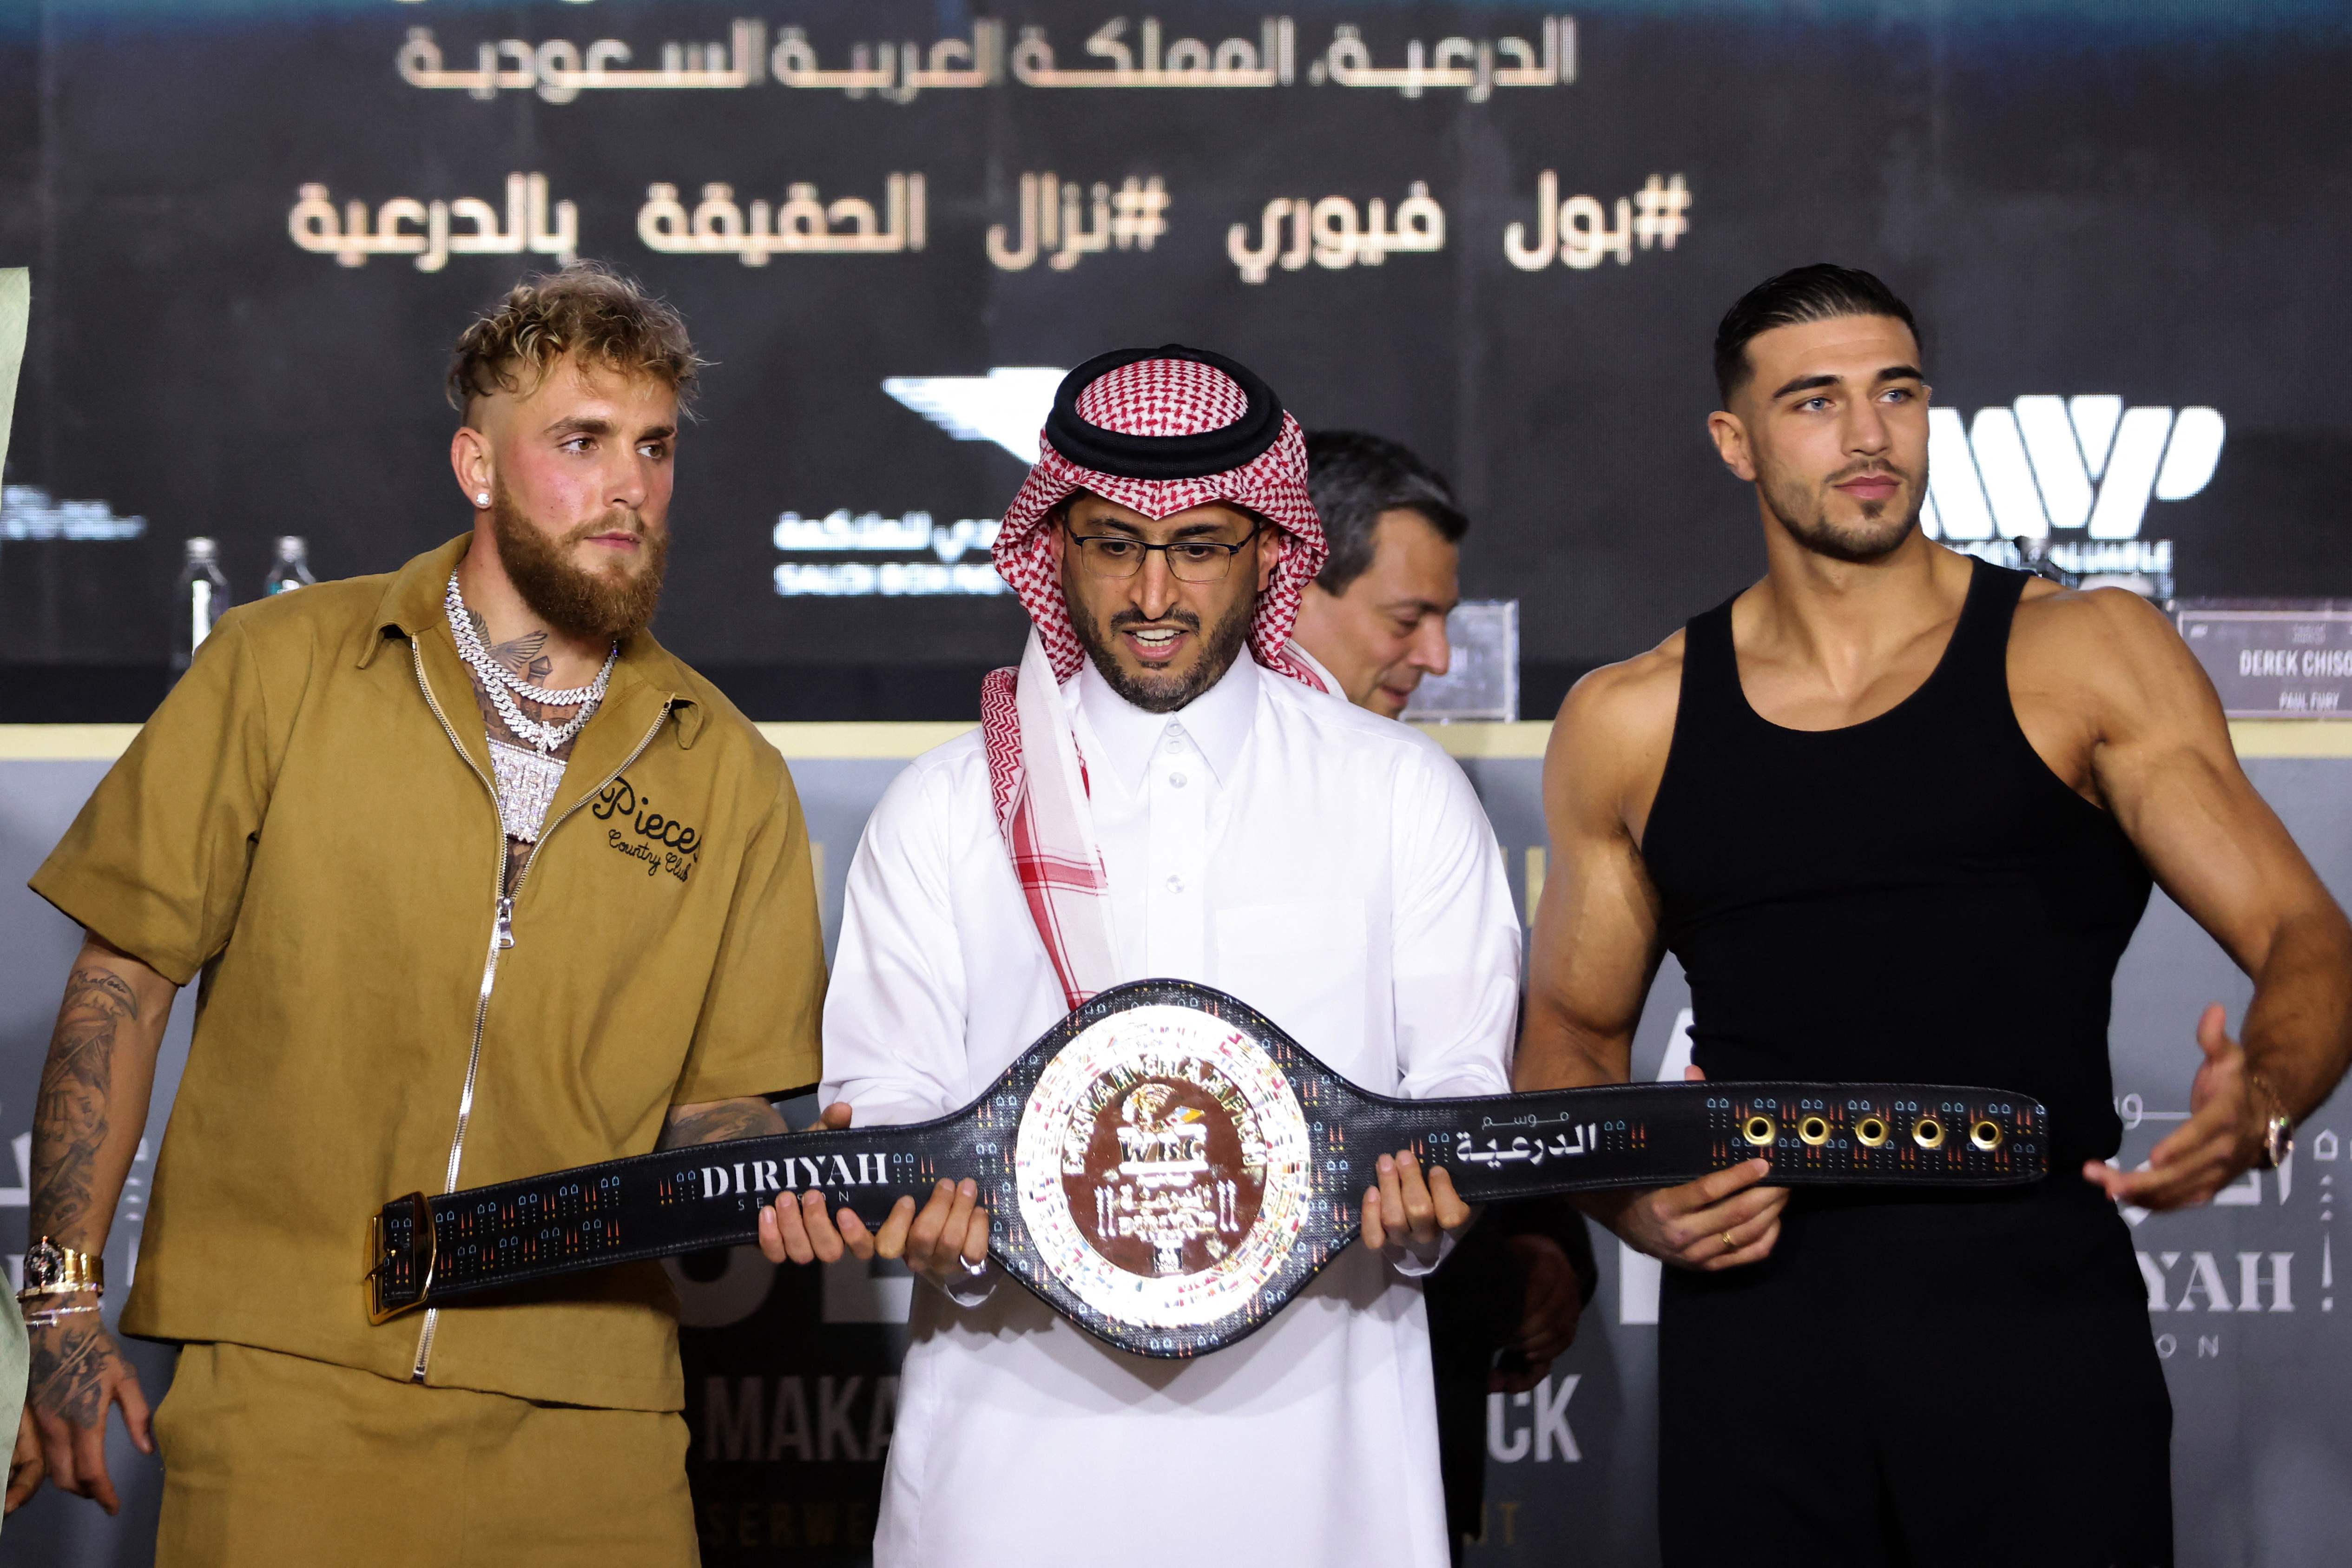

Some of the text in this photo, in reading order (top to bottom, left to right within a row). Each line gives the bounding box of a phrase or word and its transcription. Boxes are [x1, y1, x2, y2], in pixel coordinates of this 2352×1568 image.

[396, 18, 766, 103] السعودية
[771, 18, 1005, 101] العربية
[1013, 17, 1295, 87] المملكة
[289, 171, 578, 271] بالدرعية
[638, 171, 928, 267] الحقيقة
[1227, 180, 1446, 283] فيوري
[2239, 649, 2298, 677] DEREK
[609, 829, 691, 882] Country Club
[700, 1153, 889, 1199] DIRIYAH
[1456, 1121, 1597, 1169] الدرعية
